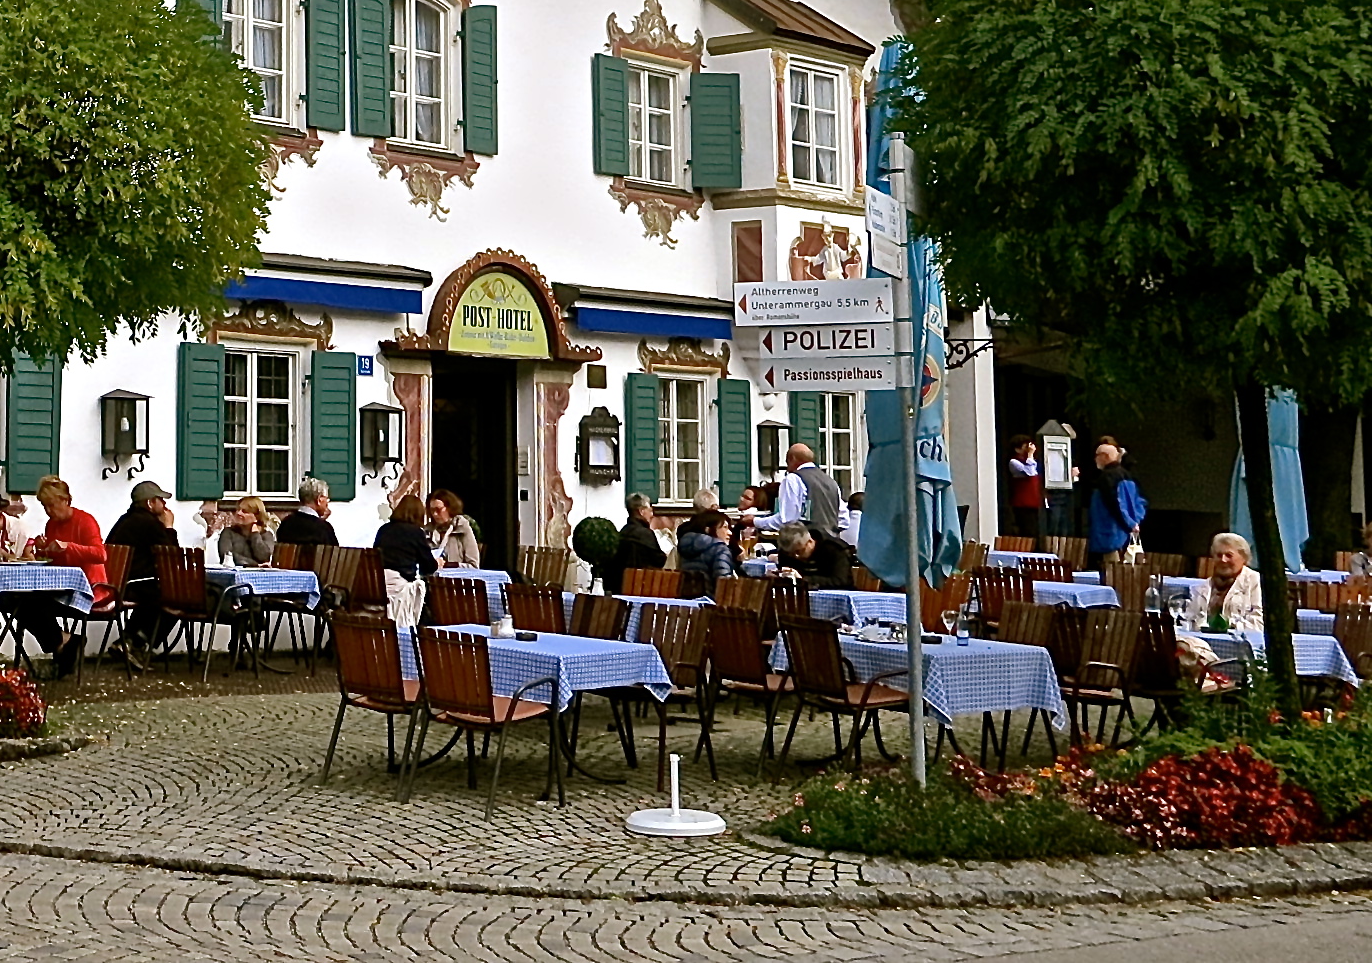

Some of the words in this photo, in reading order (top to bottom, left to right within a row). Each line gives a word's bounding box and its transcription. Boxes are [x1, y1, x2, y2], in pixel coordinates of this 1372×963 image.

[751, 287, 819, 297] Altherrenweg
[751, 300, 833, 310] Unterammergau
[853, 298, 869, 307] km
[783, 328, 875, 351] POLIZEI
[361, 357, 370, 369] 19
[784, 367, 883, 383] Passionsspielhaus
